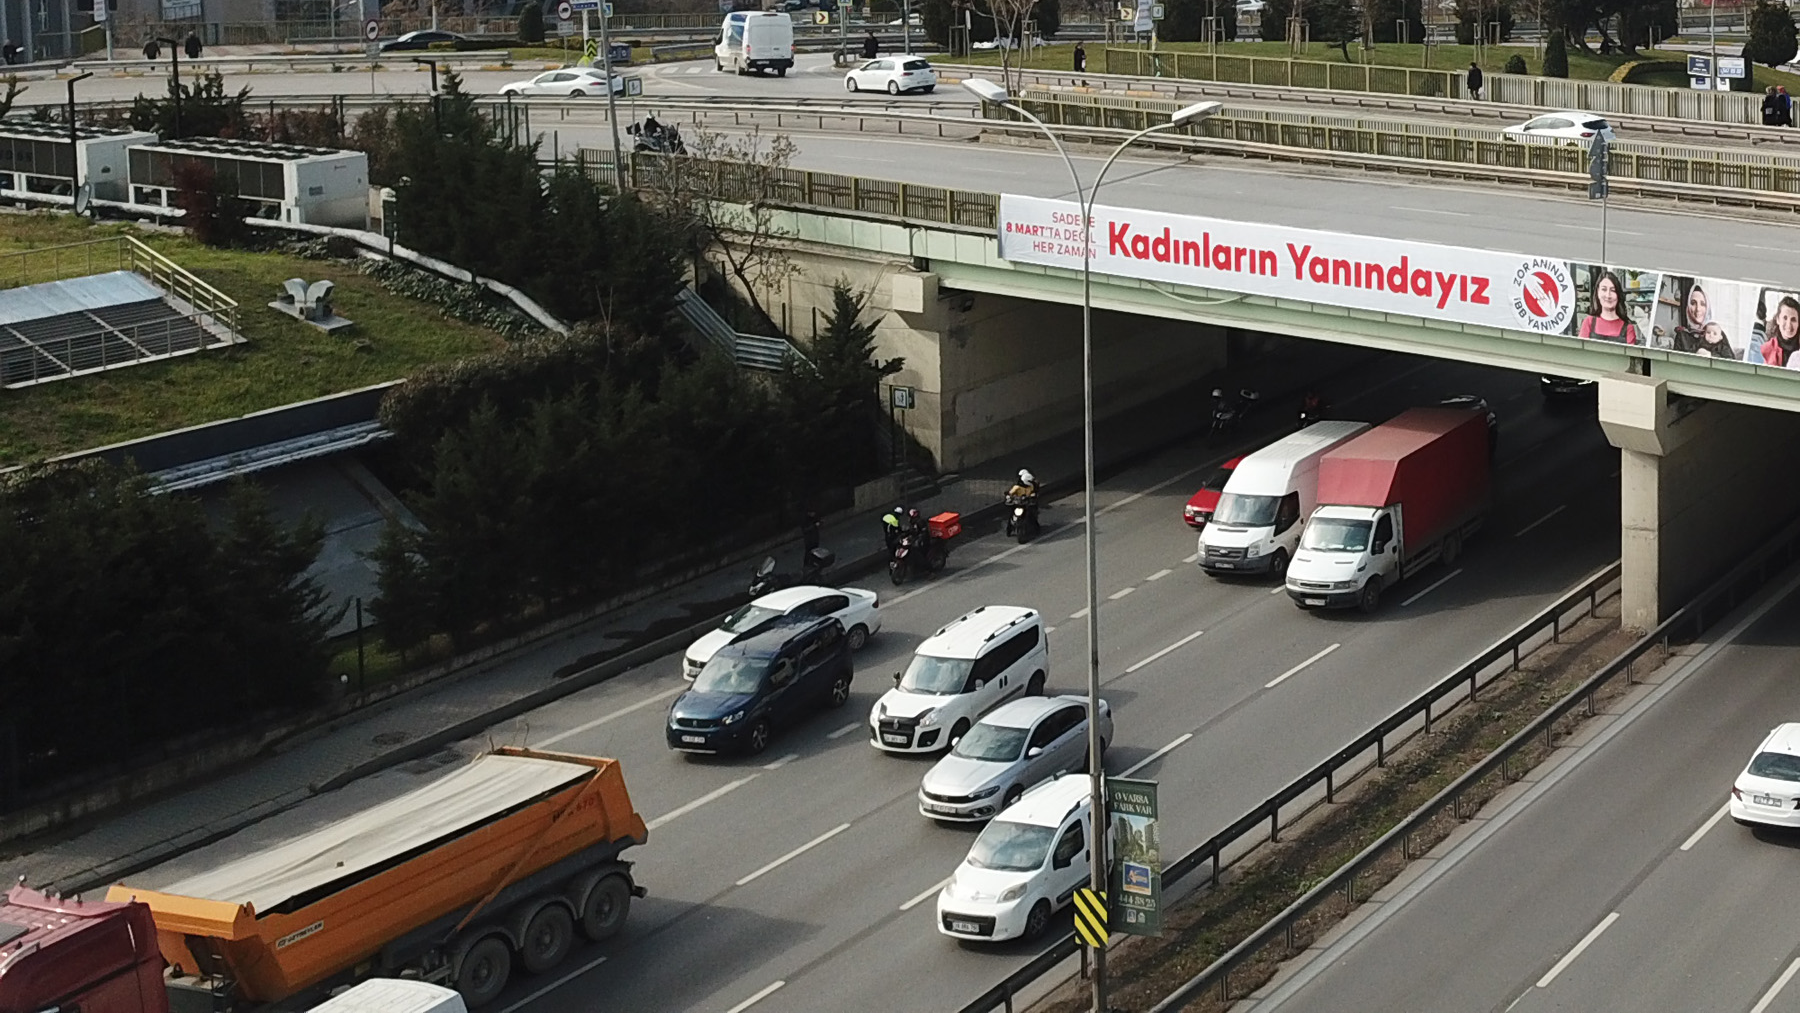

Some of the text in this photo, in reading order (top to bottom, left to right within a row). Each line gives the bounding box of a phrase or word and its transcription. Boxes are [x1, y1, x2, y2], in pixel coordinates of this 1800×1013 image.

[1052, 211, 1096, 229] SADEE
[1005, 221, 1097, 244] 8 MART'TA DEĞL
[1033, 240, 1055, 254] HER
[1108, 221, 1491, 309] Kadınların Yanındayız
[1513, 258, 1569, 293] ZOR ANINDA
[1527, 304, 1569, 331] YANINDA
[1113, 801, 1153, 816] FARK VAR
